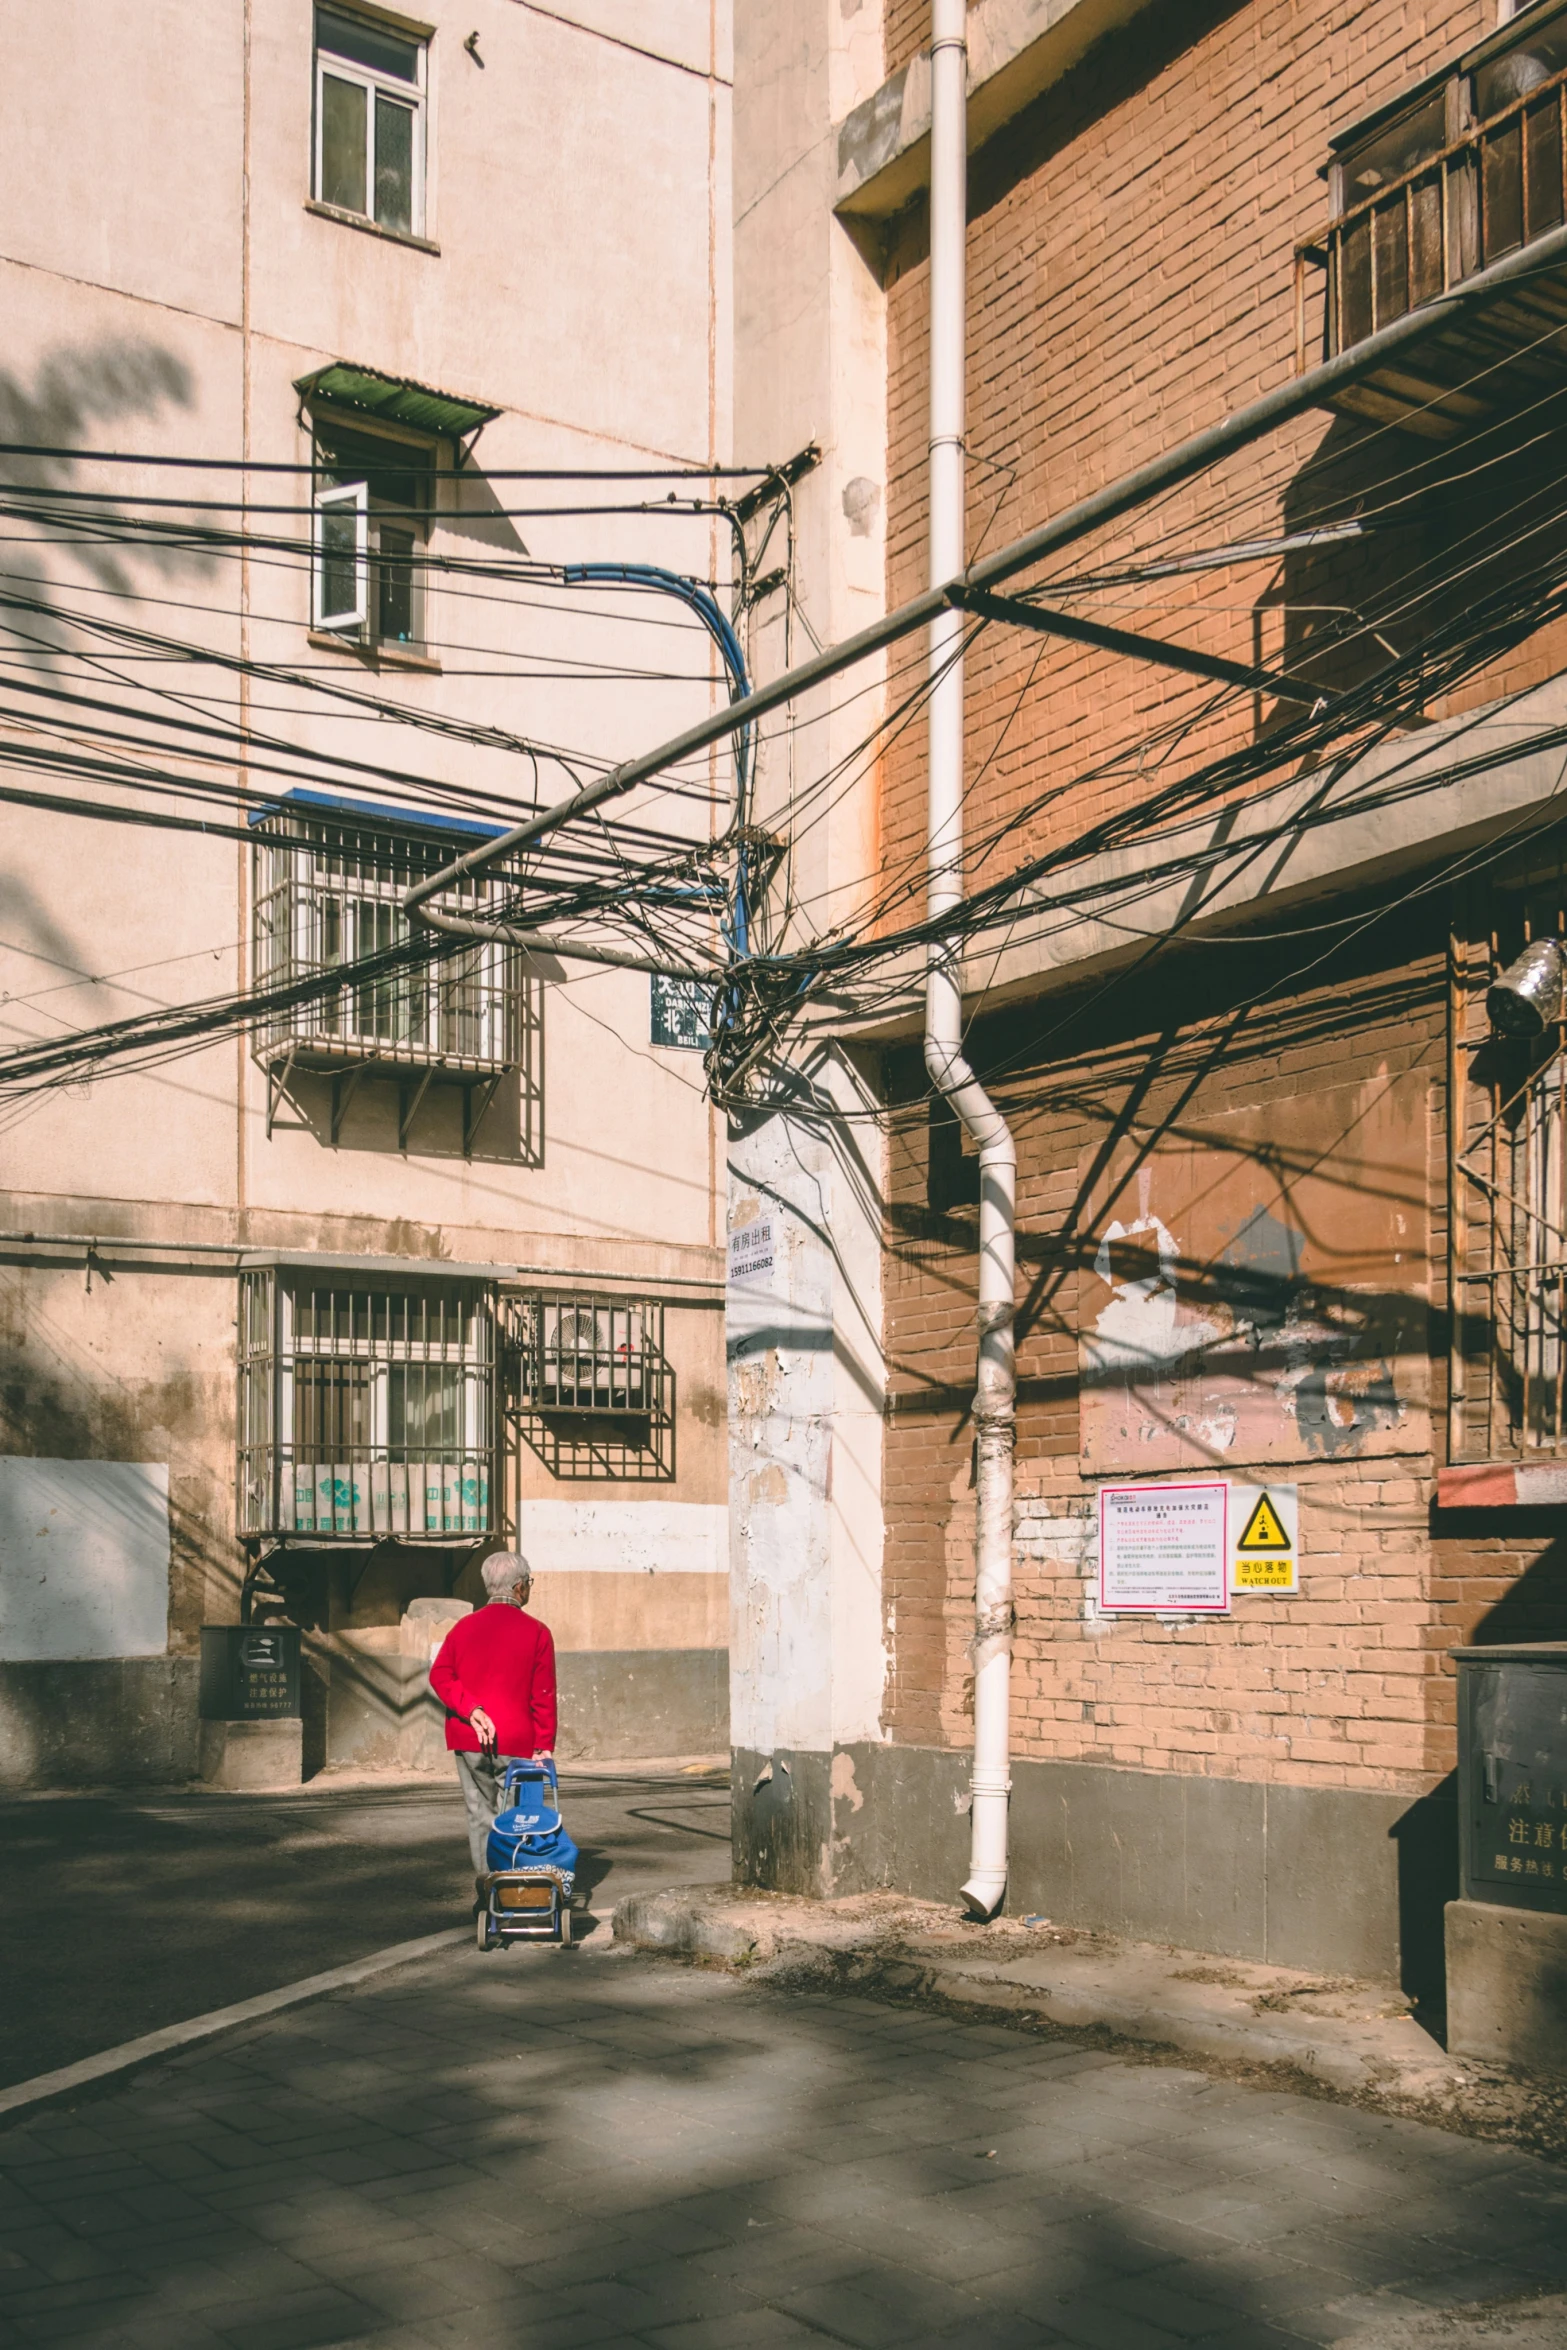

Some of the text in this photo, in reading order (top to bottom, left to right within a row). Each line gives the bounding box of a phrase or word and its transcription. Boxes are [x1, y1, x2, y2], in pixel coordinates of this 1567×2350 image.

[677, 1035, 699, 1048] BEILI
[731, 1225, 772, 1253] 有房出租
[730, 1256, 773, 1279] 15911166082
[1241, 1561, 1287, 1574] 当心落物
[249, 1687, 287, 1698] 注意保护
[1495, 1855, 1555, 1878] 服务热线
